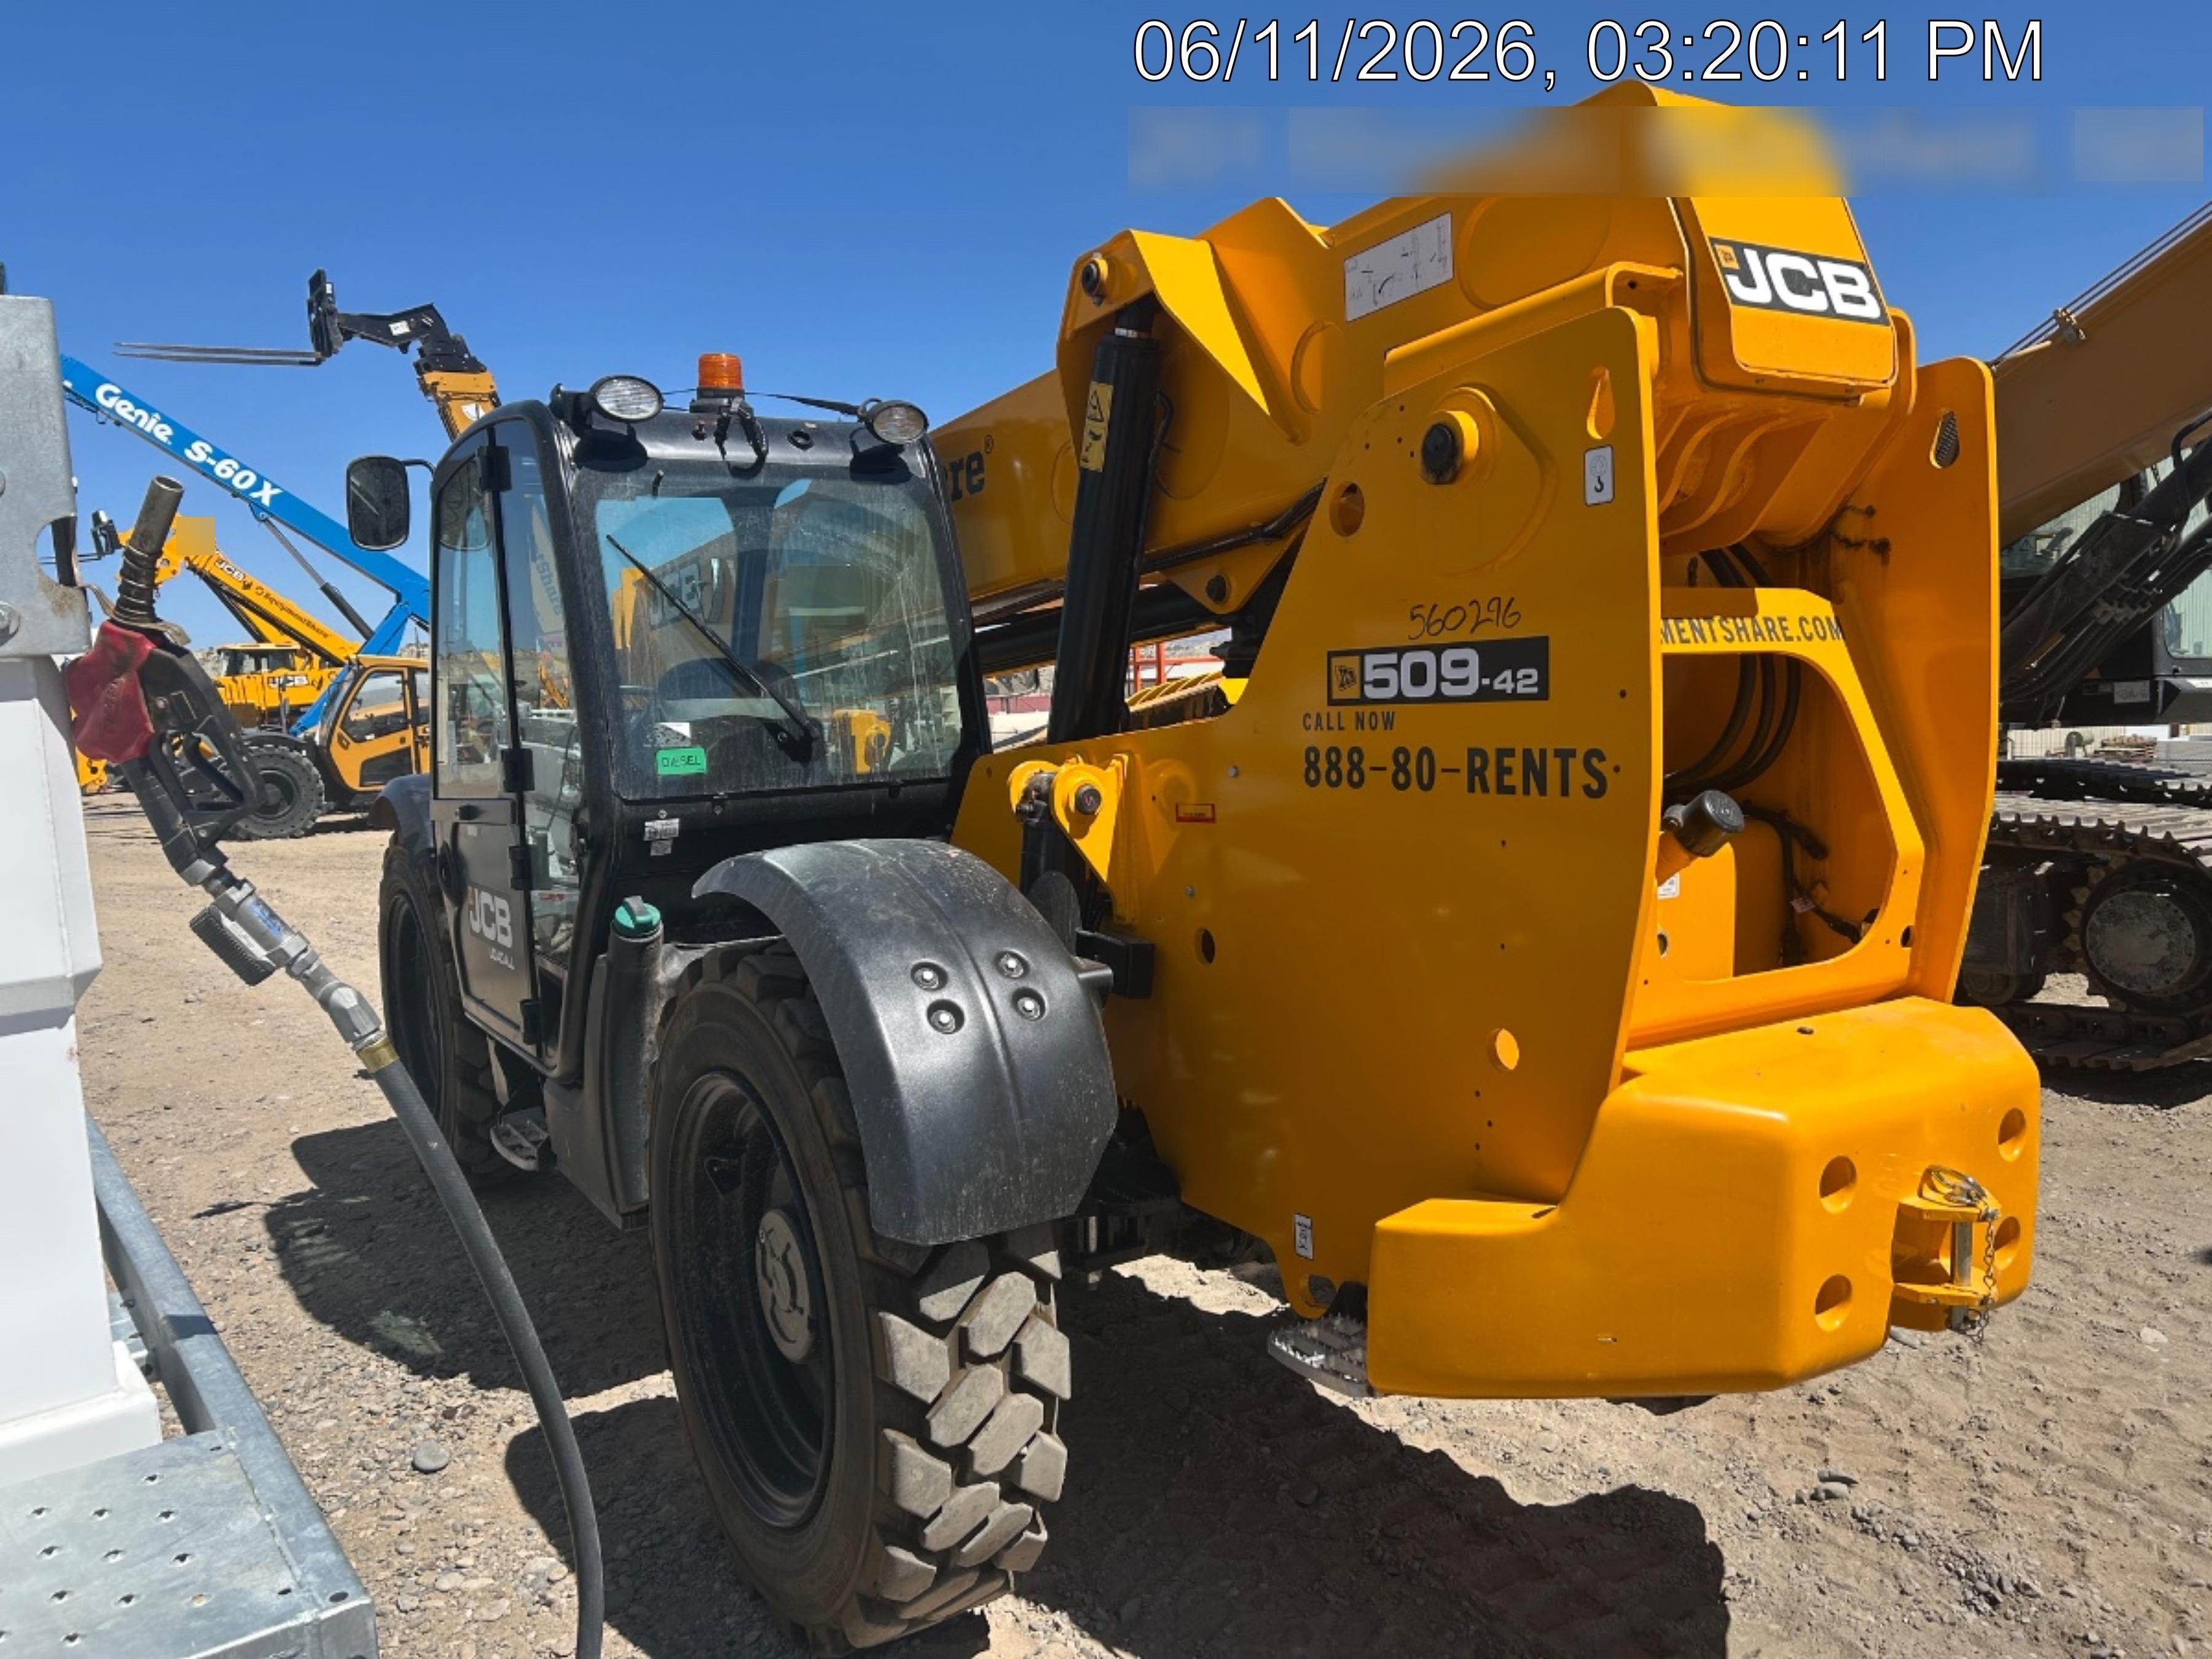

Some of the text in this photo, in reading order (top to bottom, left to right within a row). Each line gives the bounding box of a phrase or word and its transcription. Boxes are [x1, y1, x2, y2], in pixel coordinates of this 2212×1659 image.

[1725, 248, 1881, 319] JCB
[95, 383, 173, 444] Genie
[1408, 597, 1522, 640] 560296
[1363, 647, 1539, 700] 509-42
[1303, 711, 1397, 731] CALL NOW
[1303, 745, 1609, 799] 888-80-RENTS
[469, 888, 513, 948] JCB
